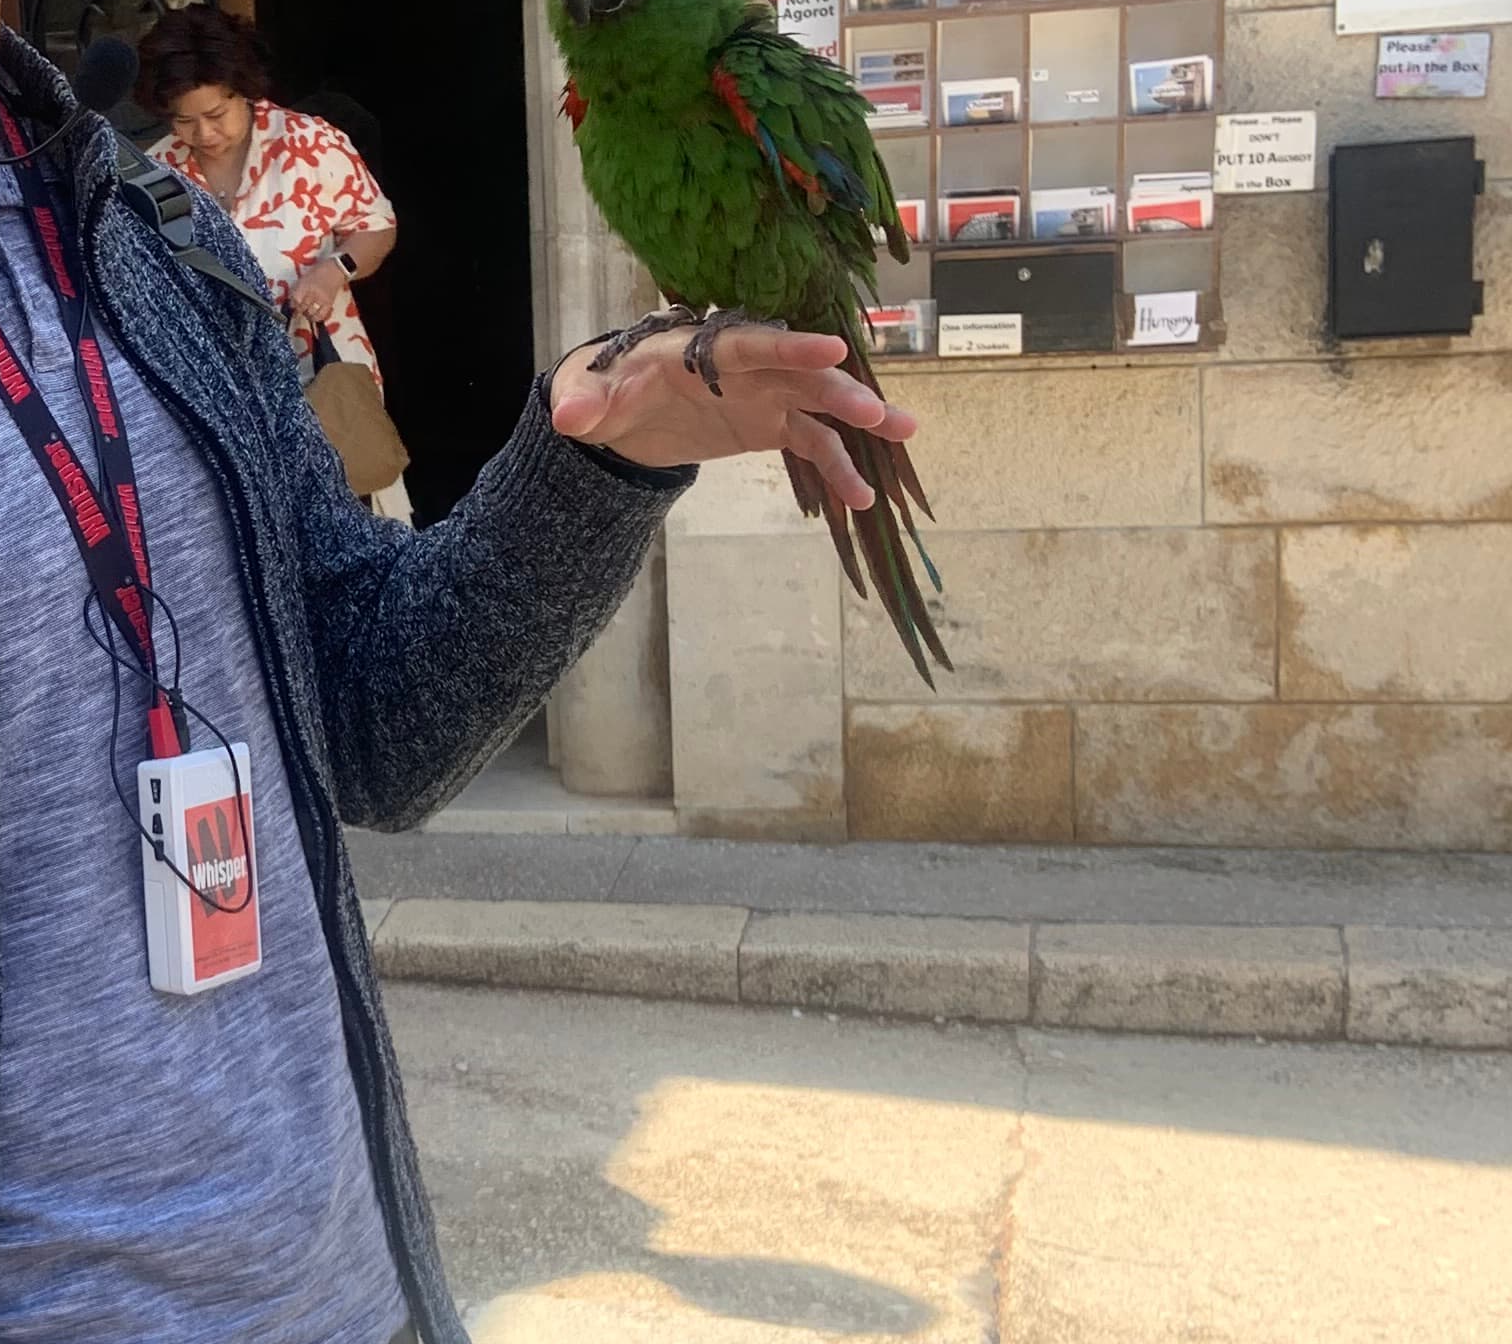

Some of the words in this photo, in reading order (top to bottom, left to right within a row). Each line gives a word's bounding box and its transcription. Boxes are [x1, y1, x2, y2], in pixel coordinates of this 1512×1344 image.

[783, 5, 834, 23] Agorot
[1387, 41, 1432, 53] Please
[1377, 62, 1403, 74] put
[1407, 61, 1420, 72] in
[1425, 61, 1448, 72] the
[1452, 60, 1479, 73] Box
[1218, 153, 1244, 166] PUT
[1248, 153, 1265, 165] 10
[1265, 177, 1291, 187] Box
[966, 340, 973, 351] 2
[79, 338, 120, 439] Whisper
[43, 440, 113, 549] Whisper
[192, 854, 248, 891] Whisper
